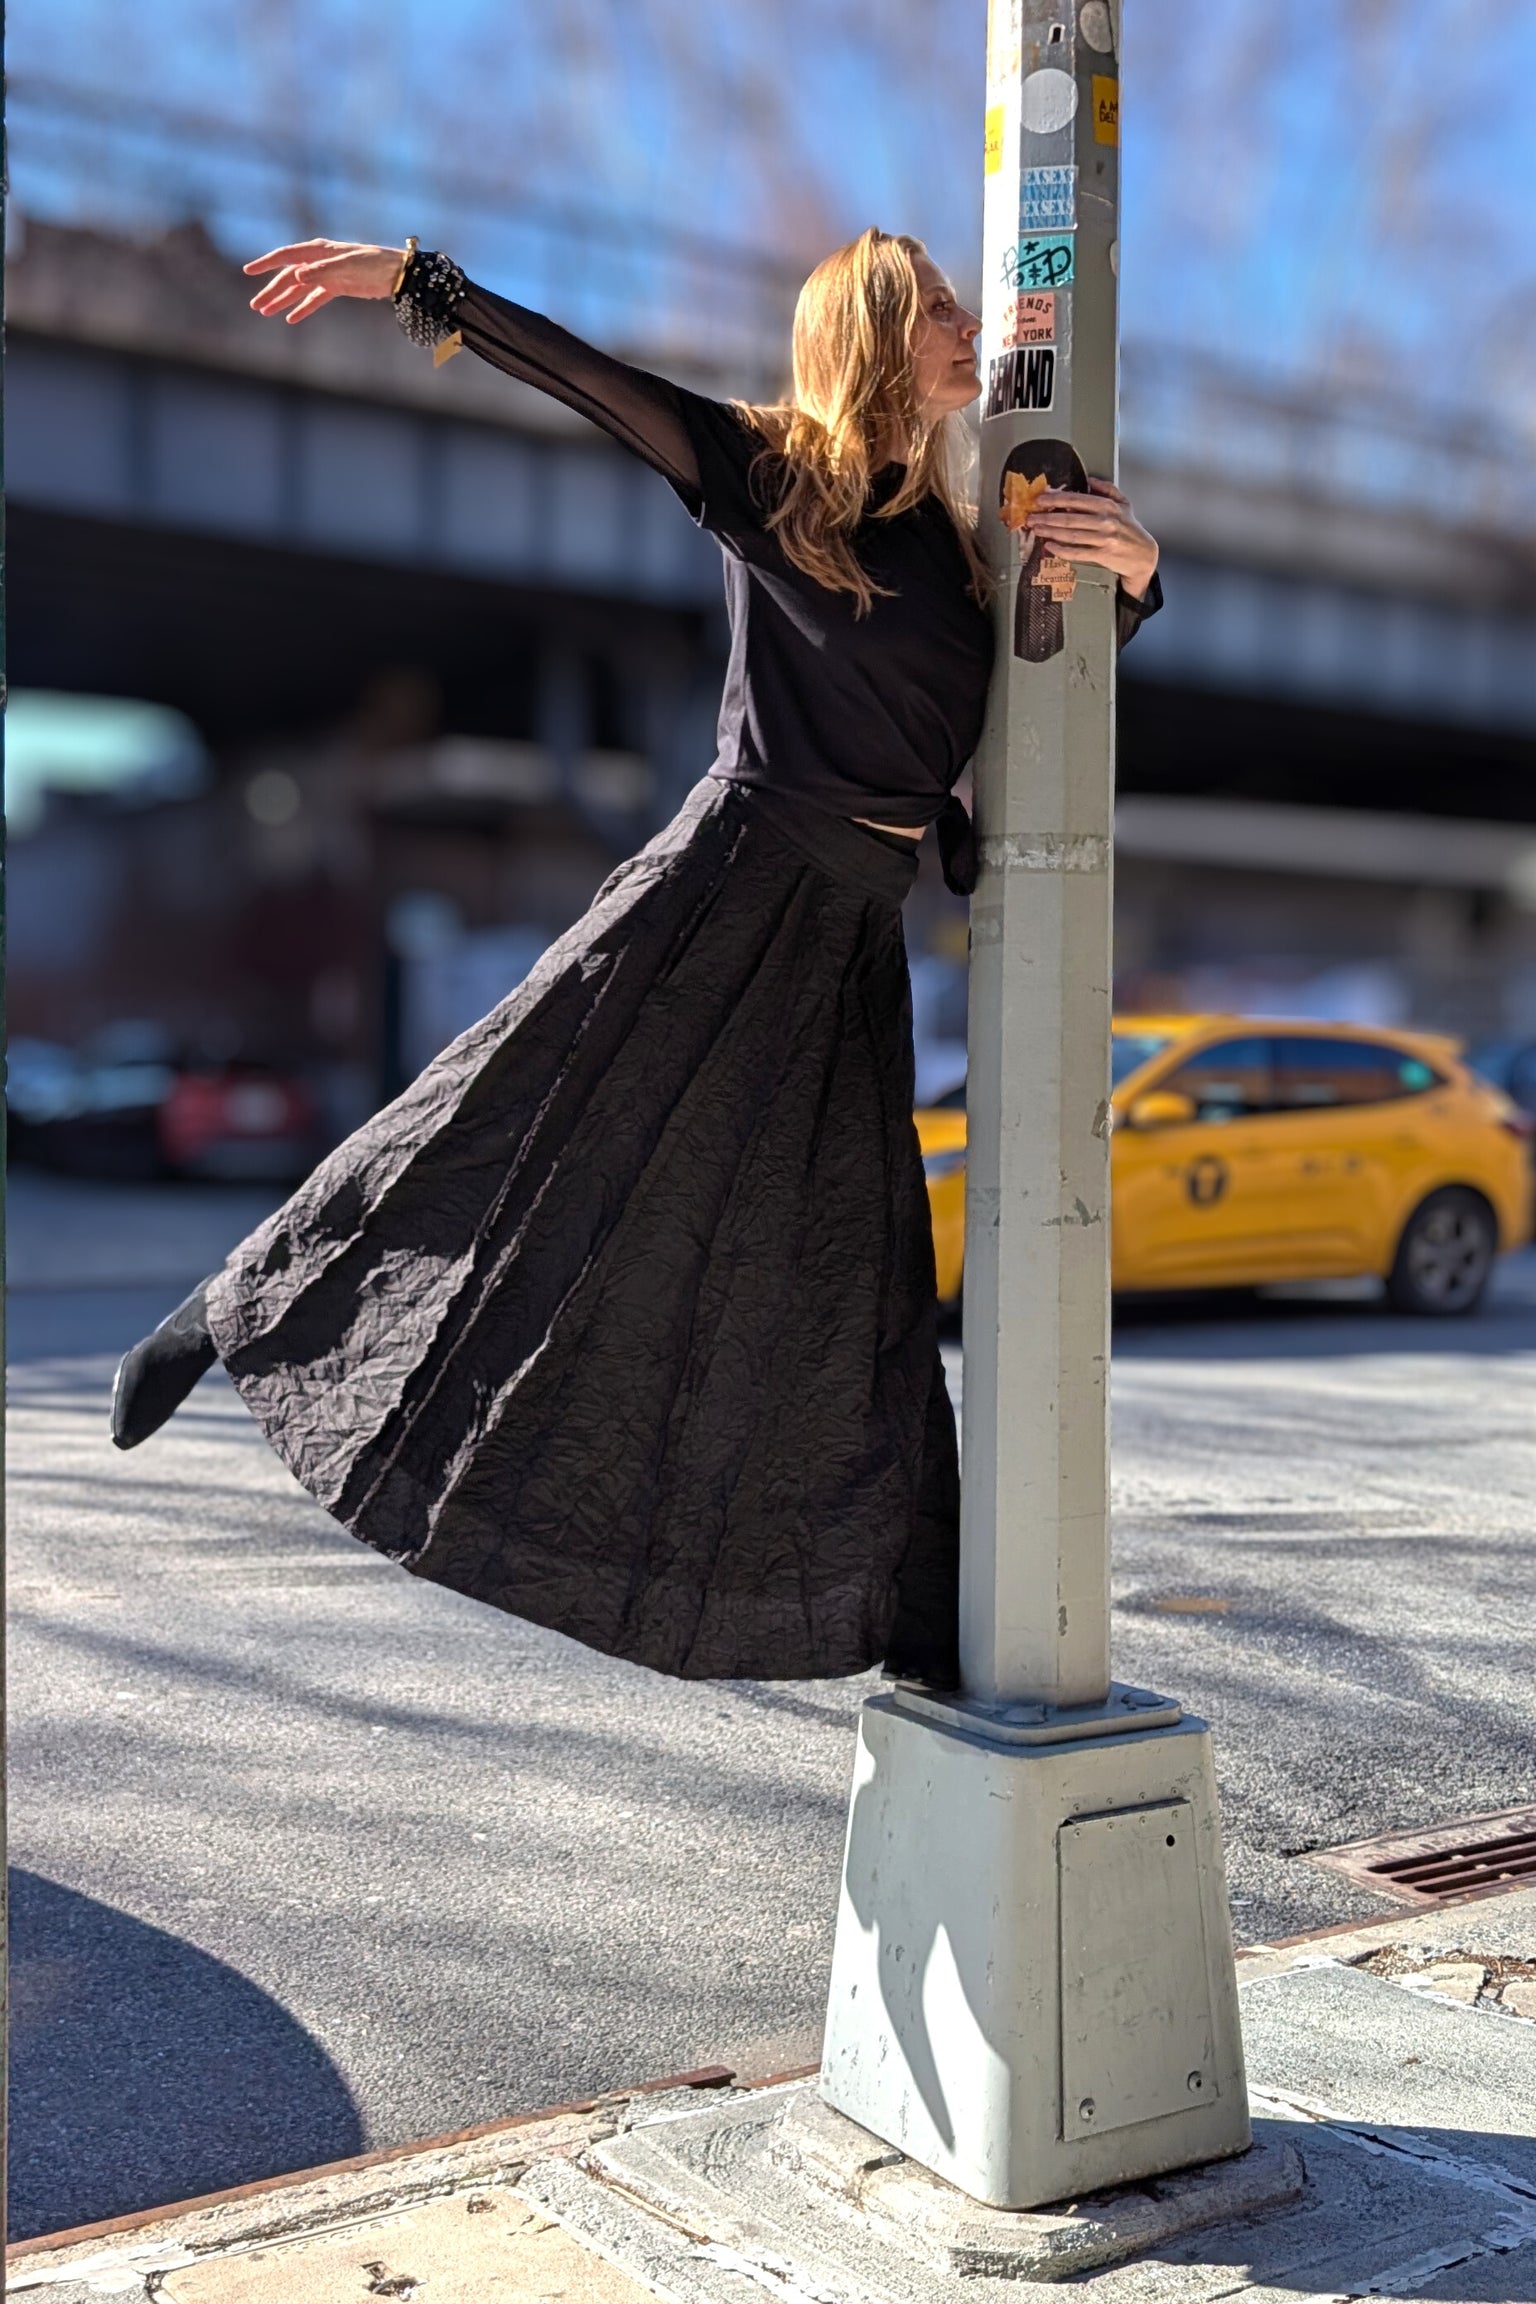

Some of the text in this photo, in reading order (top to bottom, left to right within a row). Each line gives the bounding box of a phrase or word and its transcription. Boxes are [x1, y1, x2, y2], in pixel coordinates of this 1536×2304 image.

[1023, 328, 1052, 341] YORK
[1044, 559, 1068, 568] Have
[1053, 588, 1073, 600] day!
